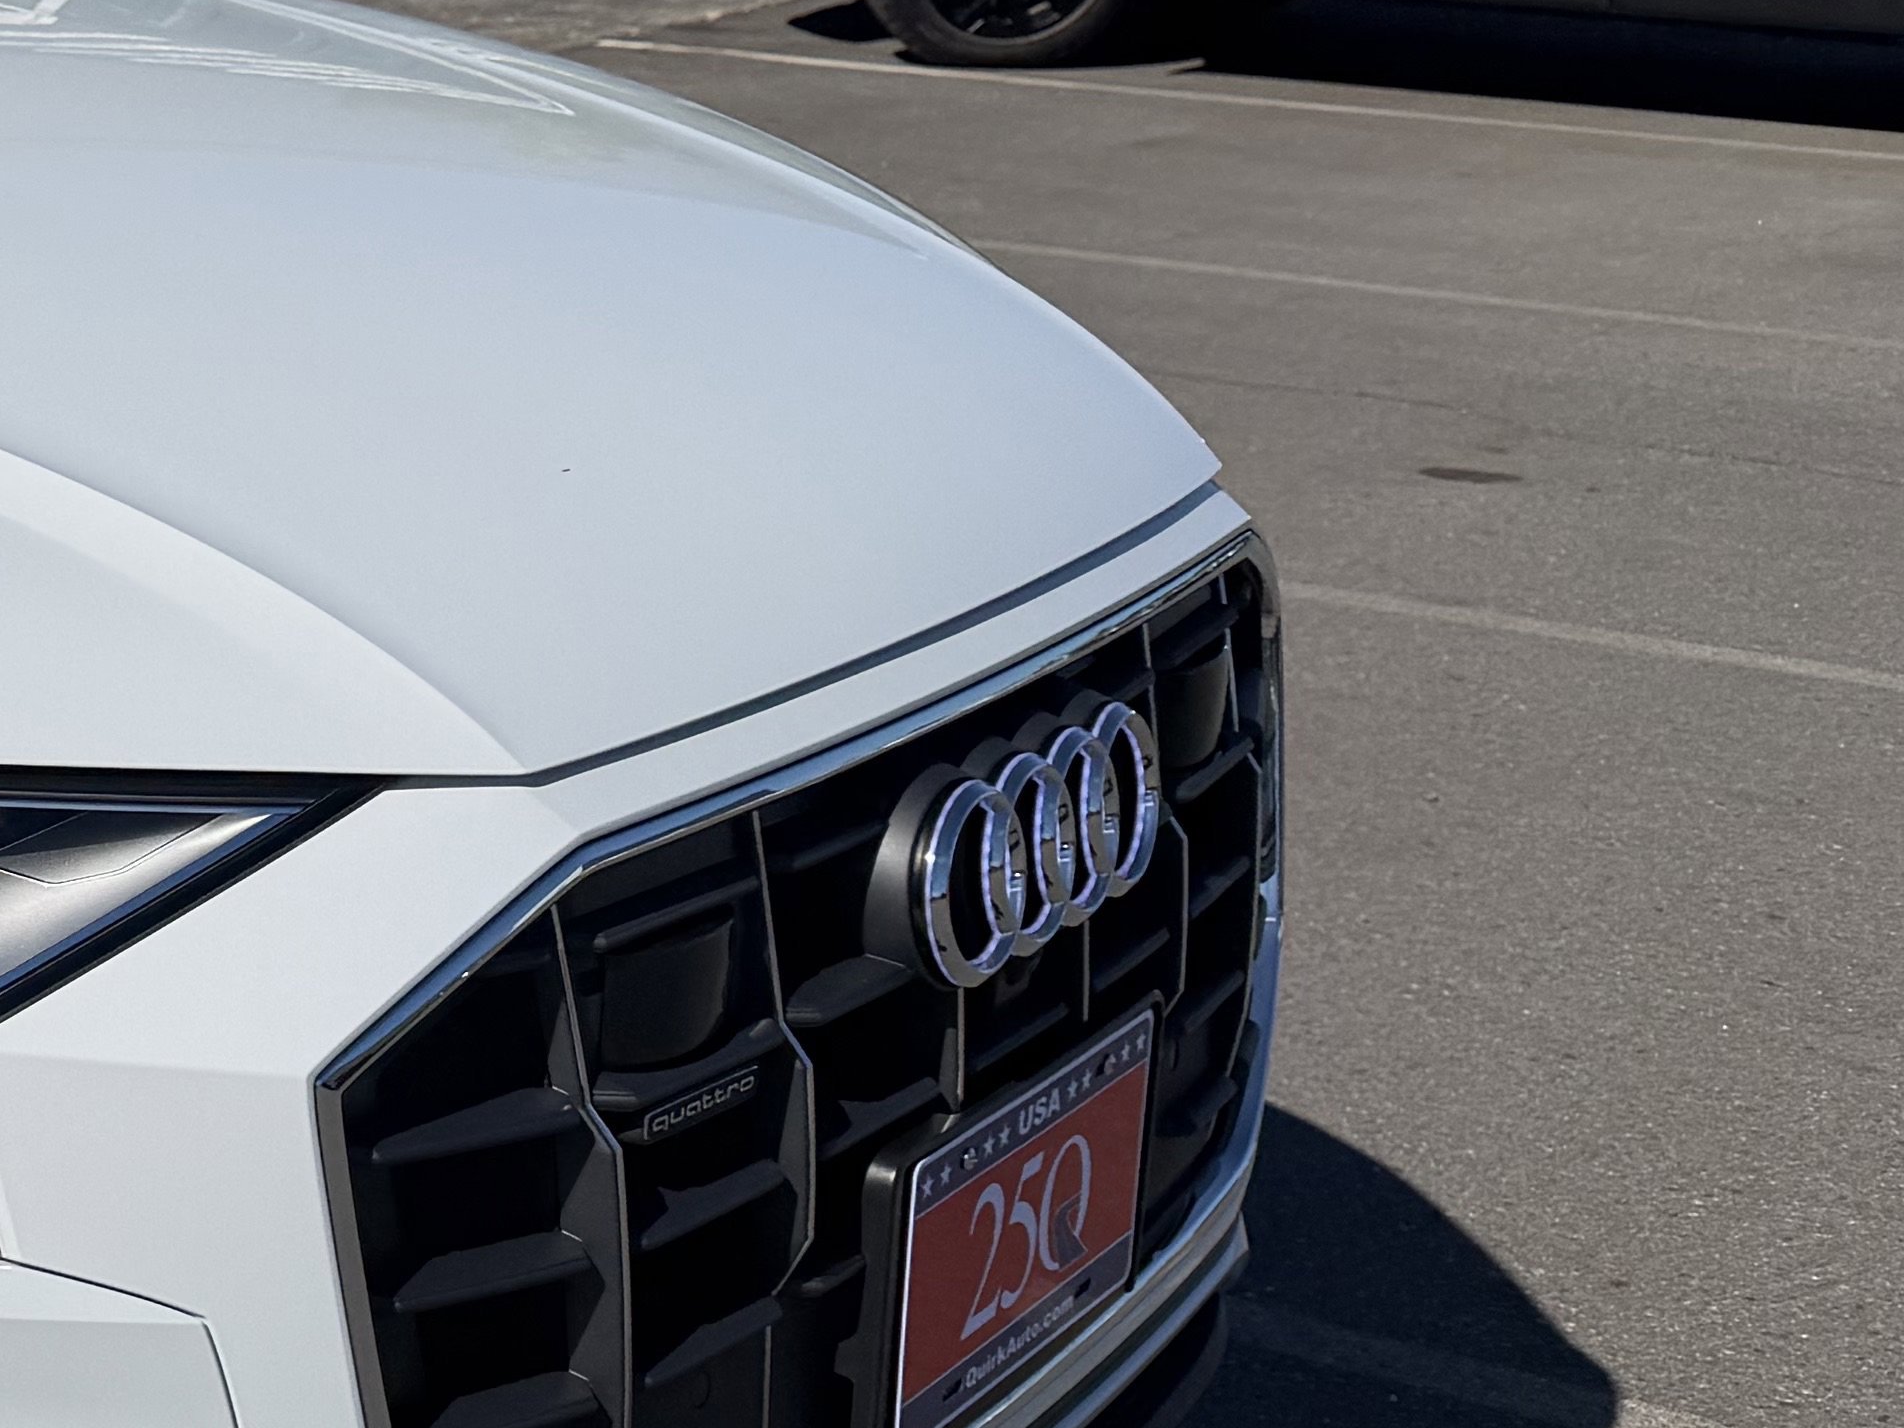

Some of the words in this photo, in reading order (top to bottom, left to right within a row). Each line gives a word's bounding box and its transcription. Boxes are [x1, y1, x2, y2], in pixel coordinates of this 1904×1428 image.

[651, 1075, 755, 1132] quattro
[1017, 1088, 1061, 1135] USA
[964, 1294, 1076, 1388] QuirkAuto.com
